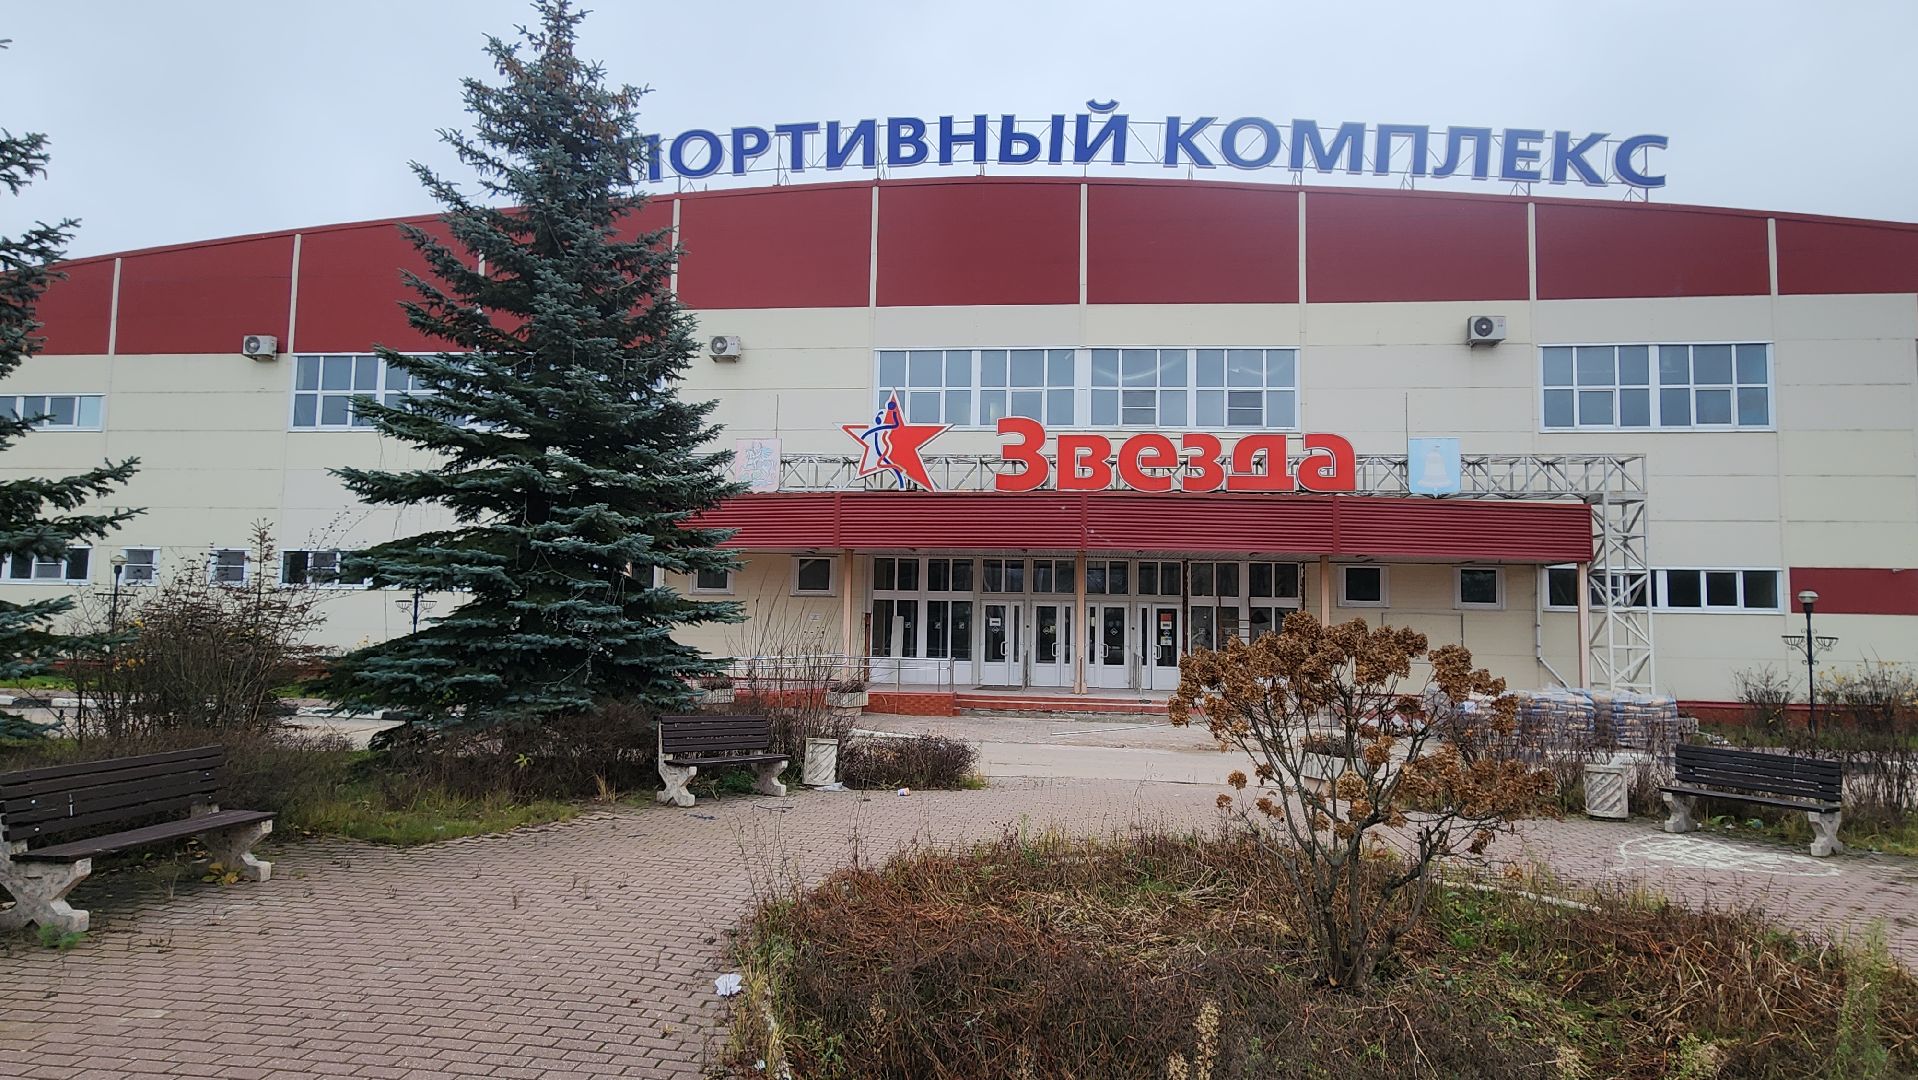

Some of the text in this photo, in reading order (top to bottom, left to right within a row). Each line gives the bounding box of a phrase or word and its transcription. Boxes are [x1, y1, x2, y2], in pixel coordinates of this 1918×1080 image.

[608, 99, 1668, 188] ПОРТИВНЫЙ КОМПЛЕКС
[995, 417, 1357, 492] Звезда
